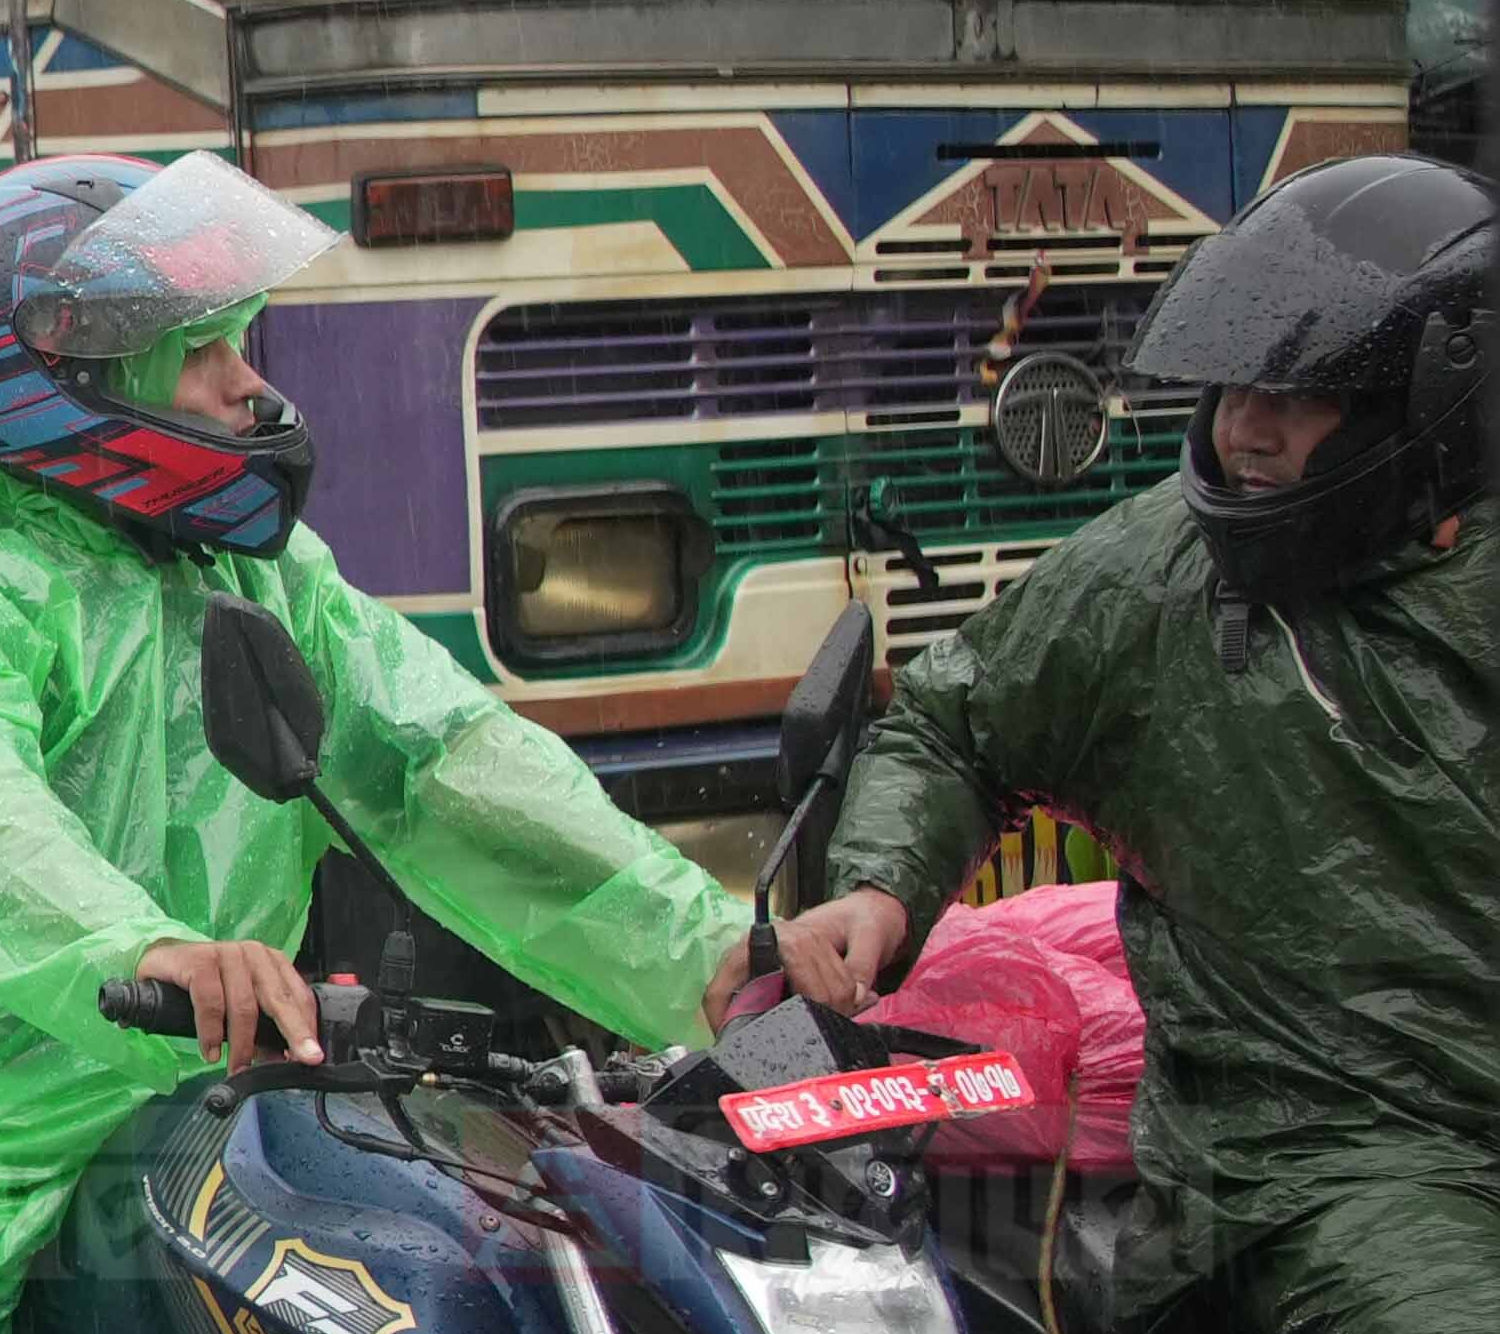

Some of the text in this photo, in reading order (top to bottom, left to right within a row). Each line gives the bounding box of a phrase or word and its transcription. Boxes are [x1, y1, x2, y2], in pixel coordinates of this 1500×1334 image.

[983, 165, 1127, 234] TATA
[737, 1095, 804, 1139] प्रदेश
[799, 1091, 833, 1128] ३
